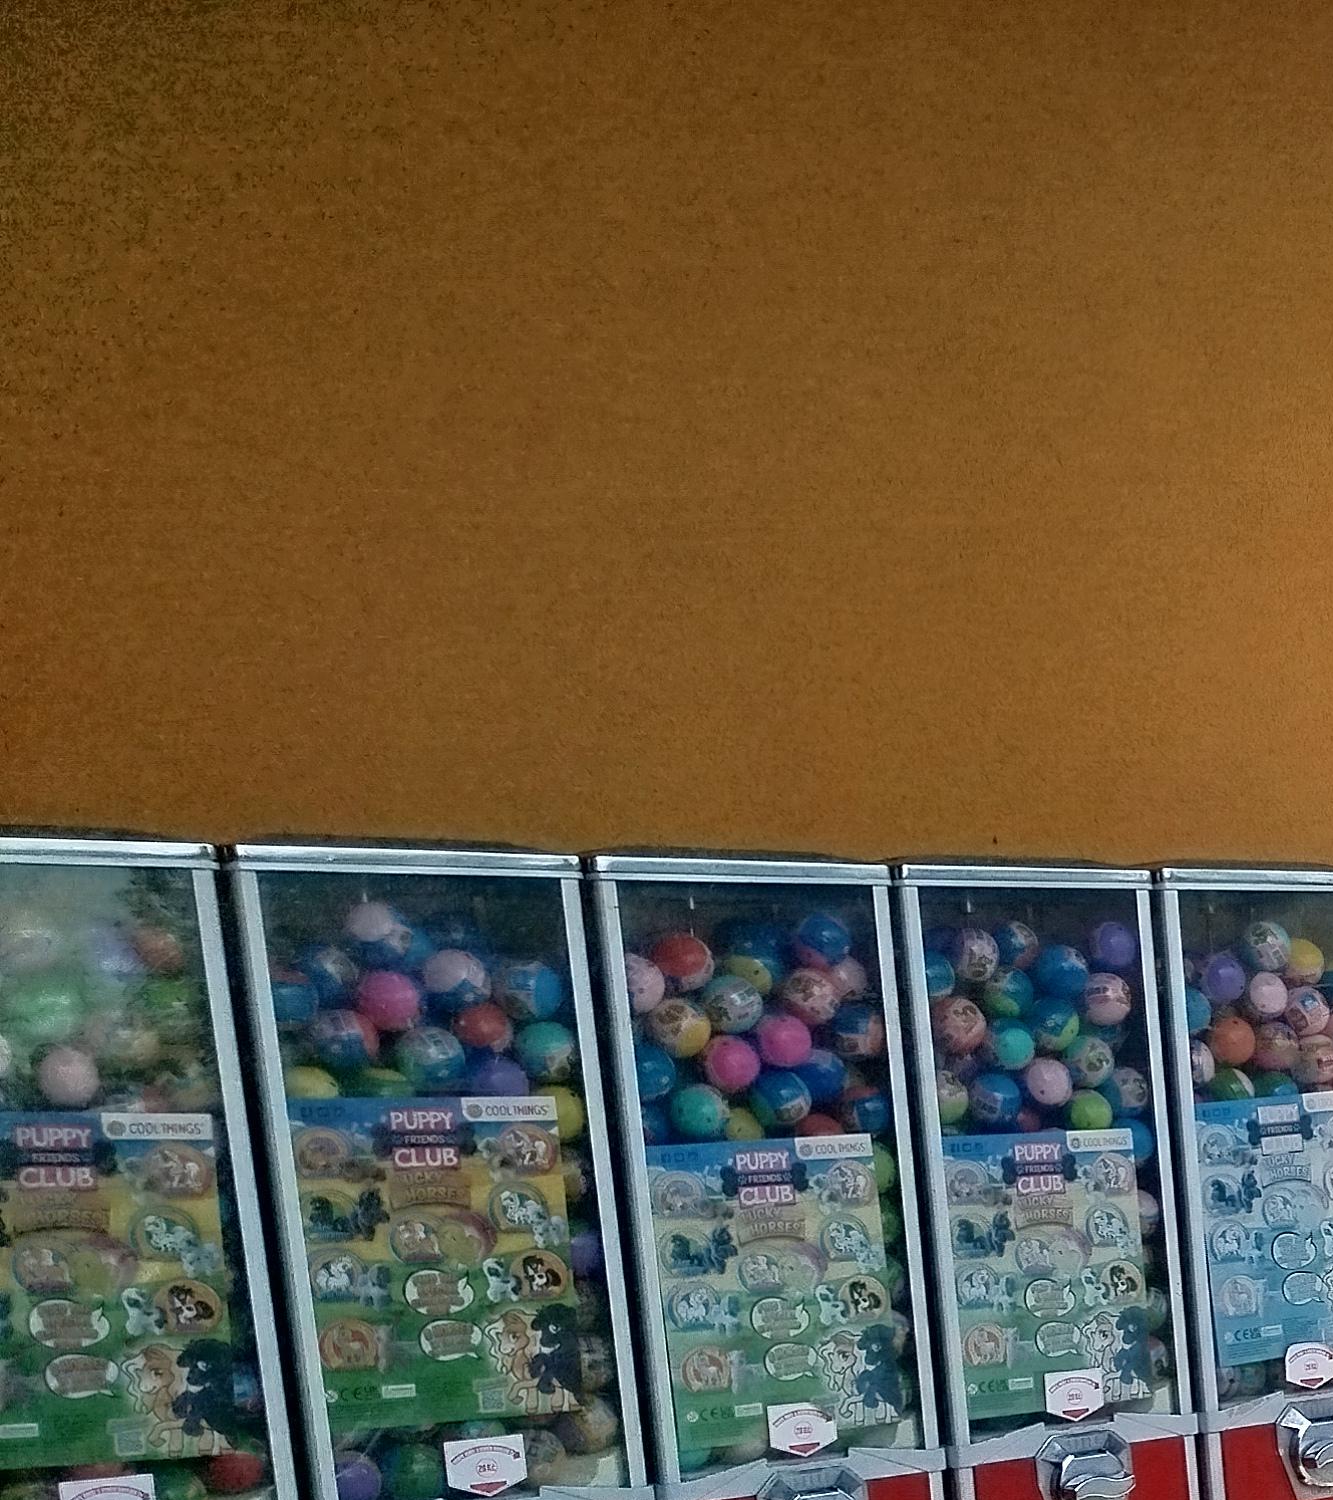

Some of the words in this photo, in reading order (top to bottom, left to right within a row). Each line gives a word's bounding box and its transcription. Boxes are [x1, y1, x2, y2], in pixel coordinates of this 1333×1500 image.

[390, 1110, 454, 1131] PUPPY
[16, 1127, 93, 1148] PUPPY
[404, 1135, 446, 1145] FRIENDS
[394, 1147, 459, 1168] CLUB
[736, 1151, 790, 1171] PUPPY
[1014, 1143, 1062, 1162] PUPPY
[19, 1167, 94, 1188] CLUB
[1017, 1175, 1064, 1194] CLUB
[740, 1186, 794, 1205] CLUB
